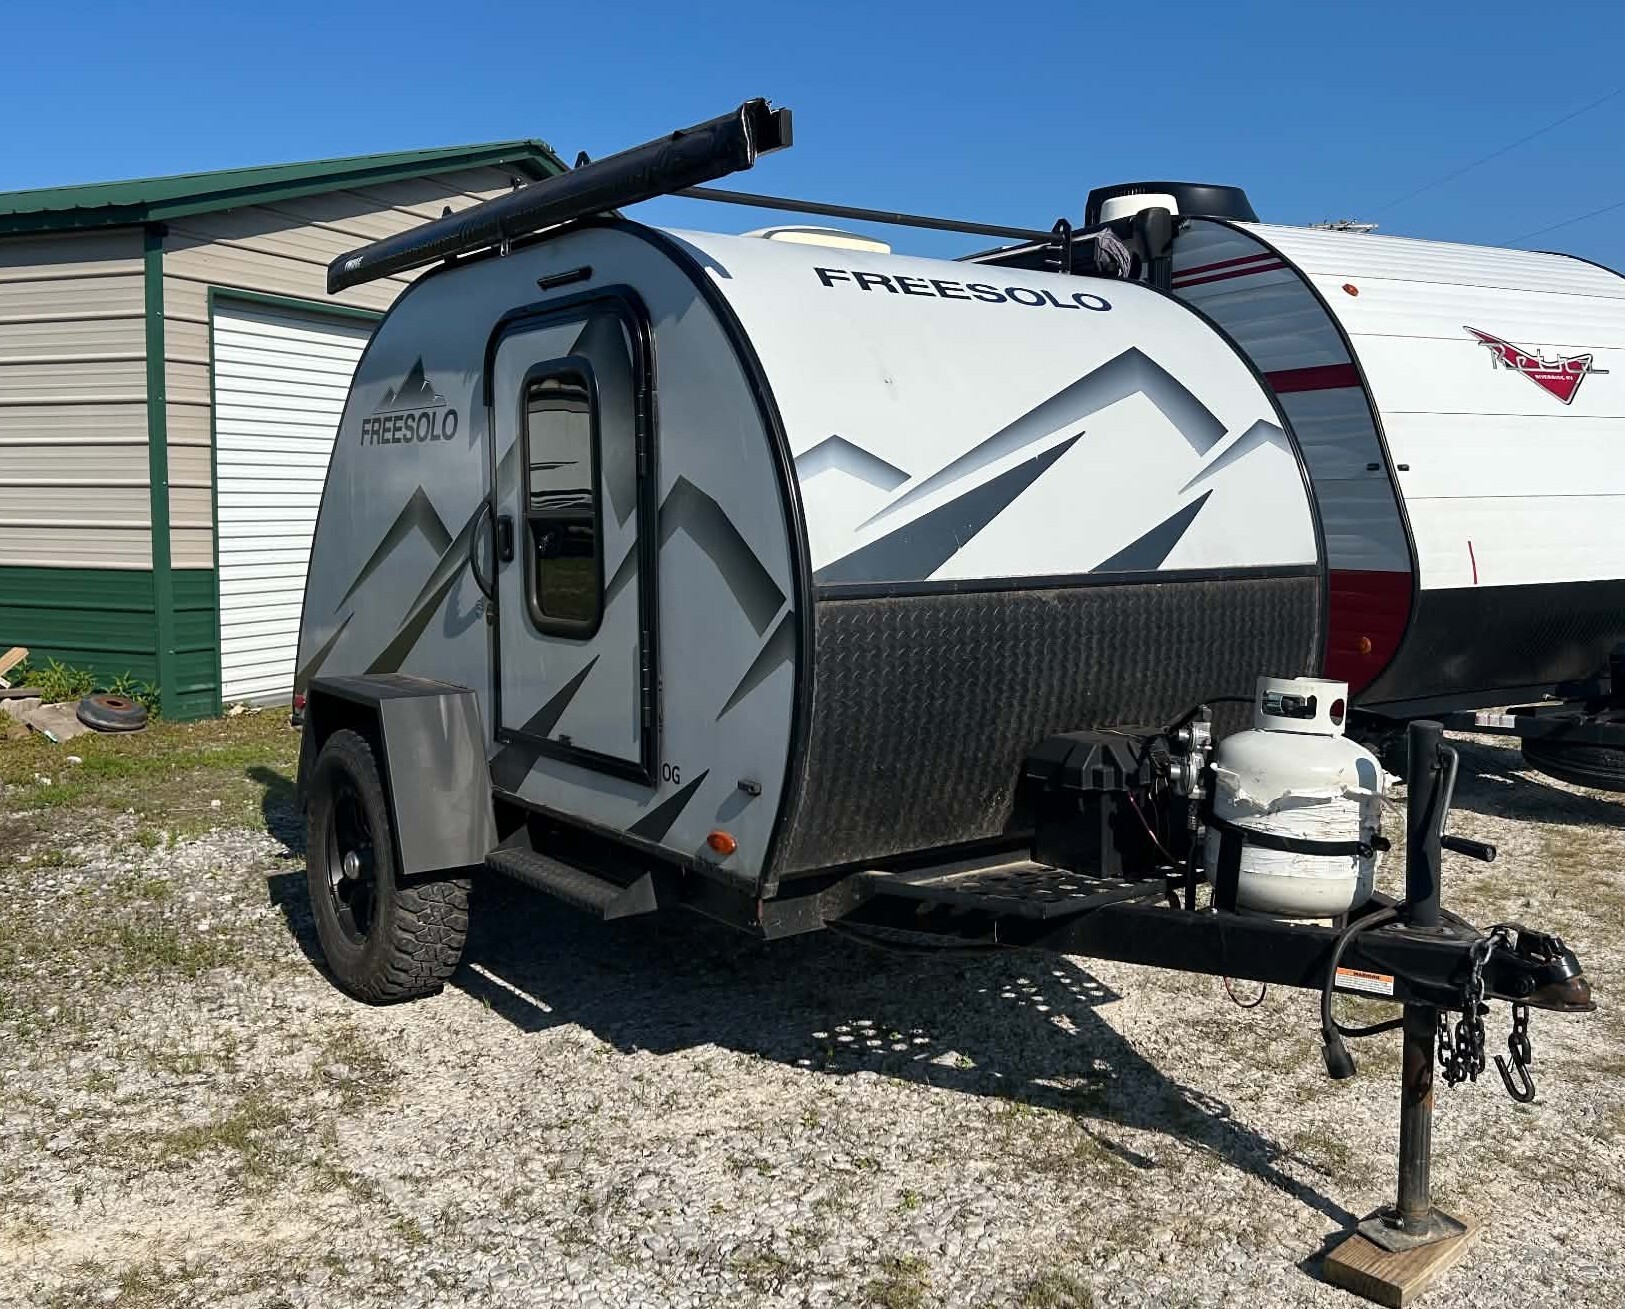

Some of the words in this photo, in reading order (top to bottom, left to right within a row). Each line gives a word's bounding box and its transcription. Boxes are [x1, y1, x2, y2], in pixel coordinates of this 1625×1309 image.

[813, 266, 1112, 312] FREESOLO
[361, 408, 459, 446] FREESOLO
[662, 762, 681, 785] OG
